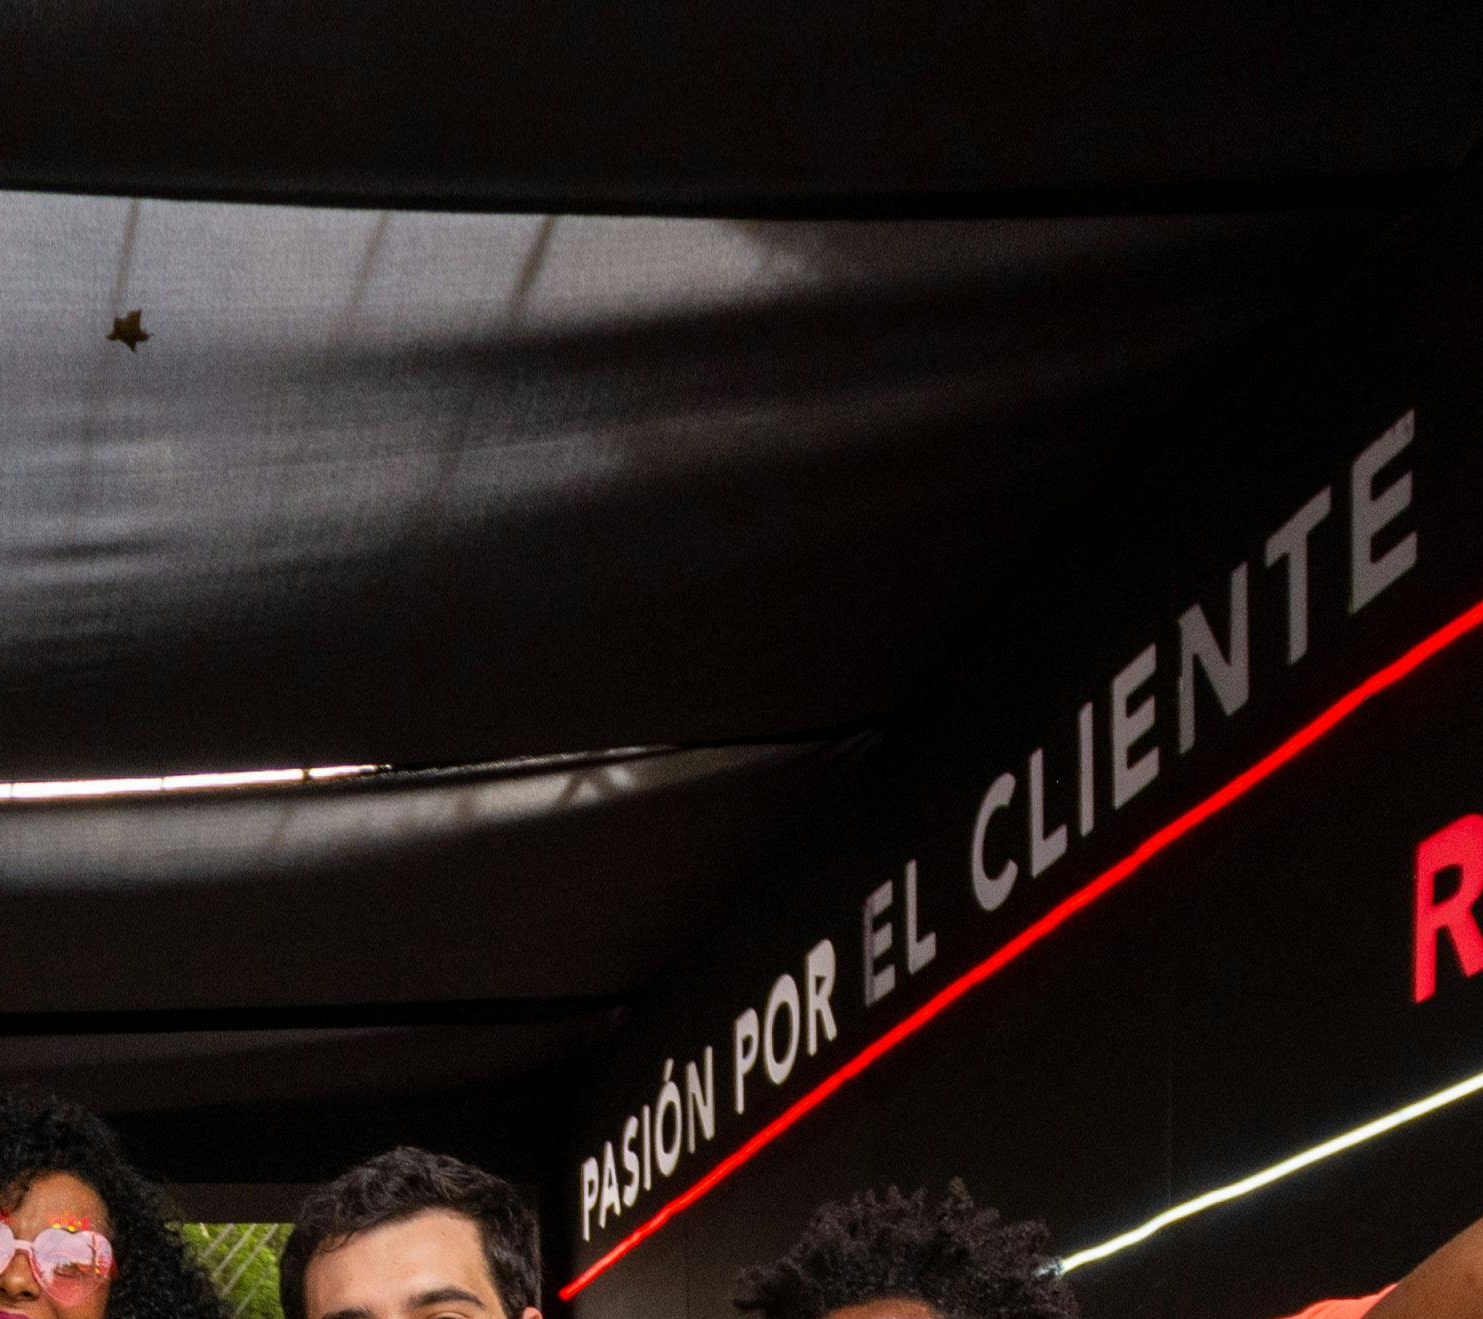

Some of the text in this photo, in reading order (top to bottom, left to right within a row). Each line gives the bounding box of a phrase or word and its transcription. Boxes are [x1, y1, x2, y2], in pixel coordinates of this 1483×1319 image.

[580, 407, 1420, 1242] PASIÓN POR EL CLIENTE
